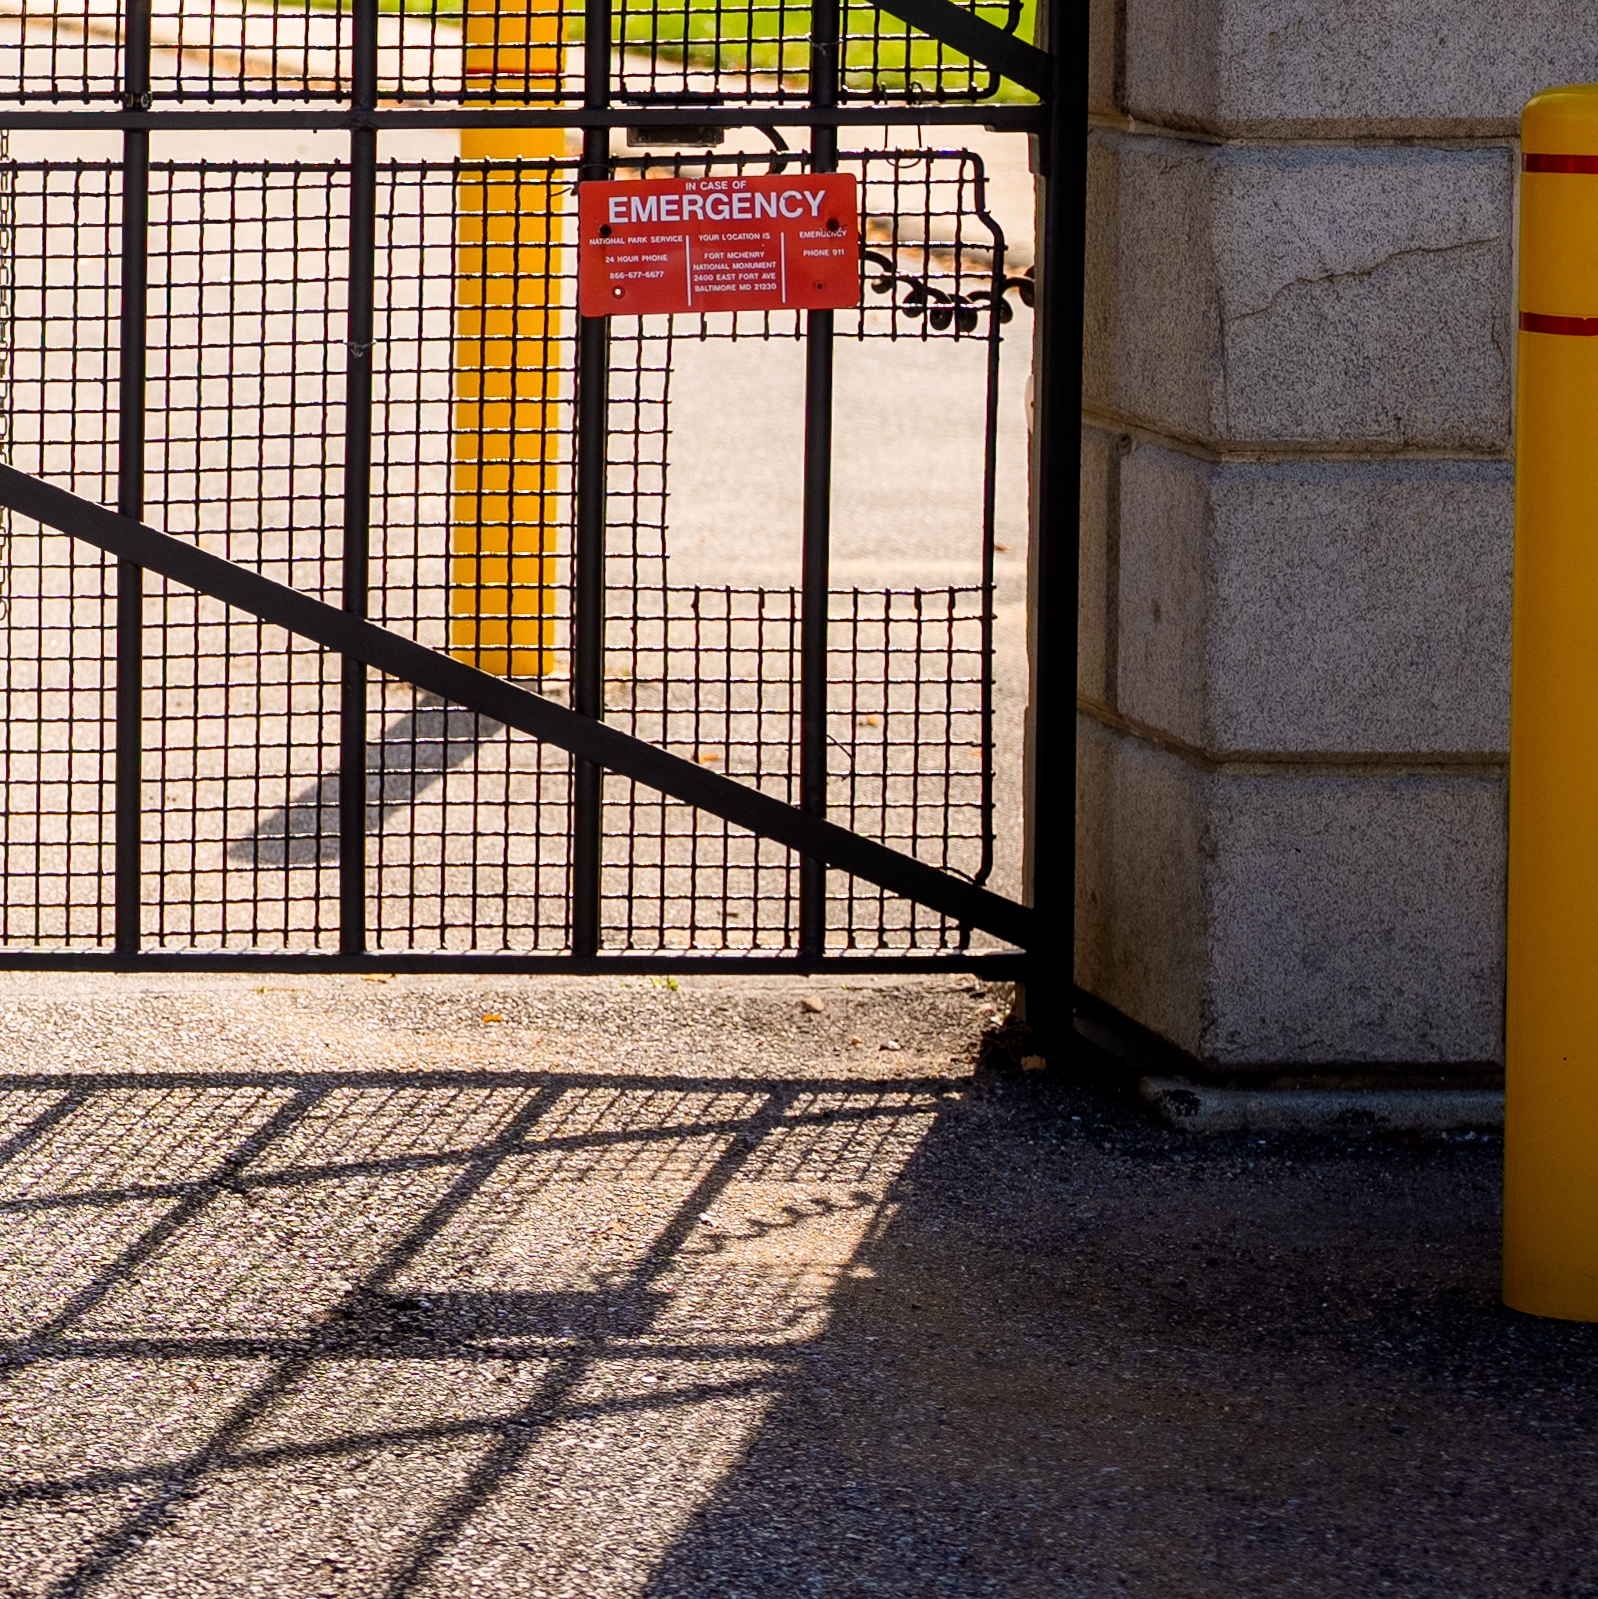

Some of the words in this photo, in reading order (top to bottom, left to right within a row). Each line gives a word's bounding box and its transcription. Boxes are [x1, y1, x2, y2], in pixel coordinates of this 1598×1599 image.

[685, 182, 696, 190] IN
[700, 181, 729, 190] CASE
[732, 180, 747, 189] OF
[608, 190, 826, 223] EMERGENCY
[589, 237, 625, 245] NATIONAL
[628, 236, 648, 244] PARK
[651, 235, 683, 244] SERVICE
[722, 232, 760, 240] LOCATION
[727, 251, 764, 259] MCHENRY
[609, 271, 664, 279] 866-677-6677
